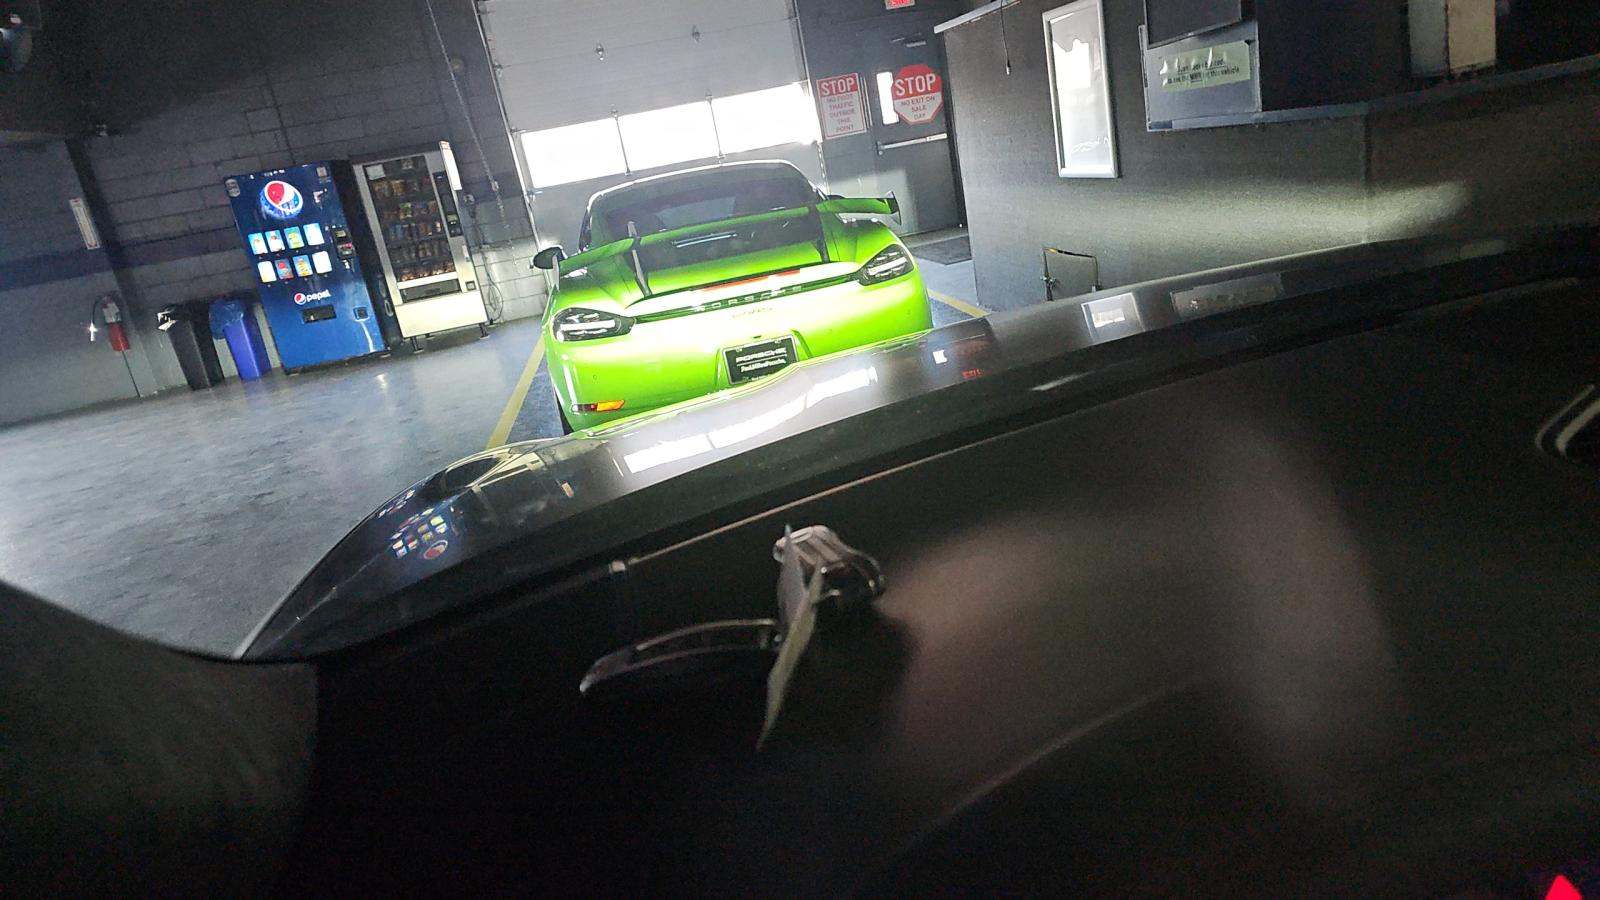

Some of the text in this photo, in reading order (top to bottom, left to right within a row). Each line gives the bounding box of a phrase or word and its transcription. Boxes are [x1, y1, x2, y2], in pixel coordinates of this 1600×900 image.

[821, 77, 855, 95] STOP
[895, 73, 936, 96] STOP
[306, 289, 331, 302] pepsi
[735, 347, 787, 363] PORSCHE
